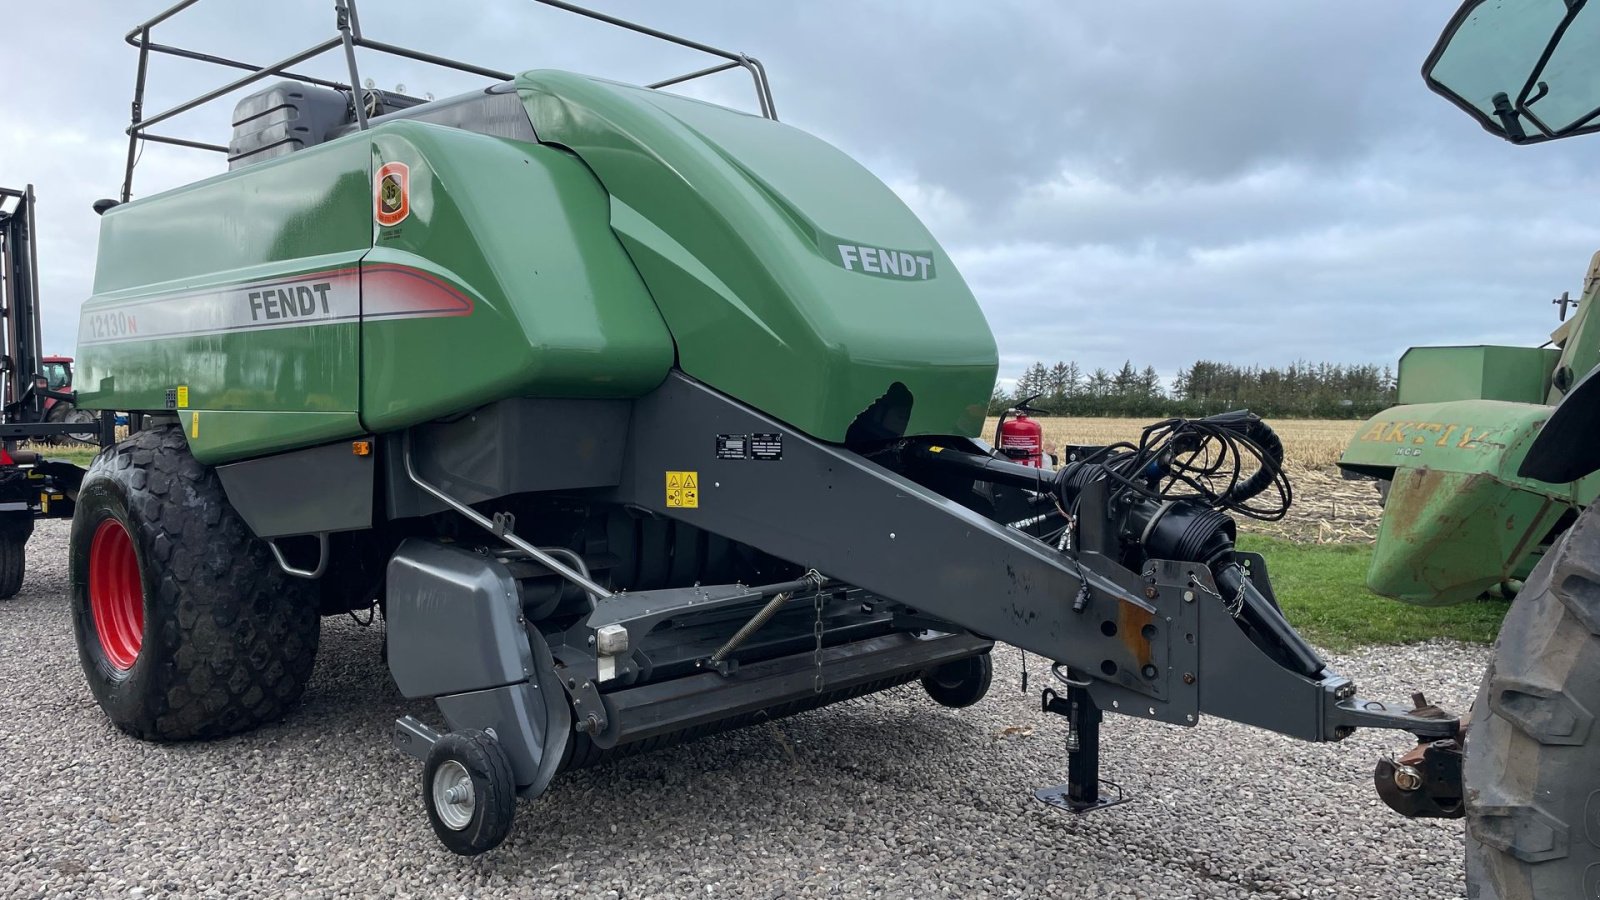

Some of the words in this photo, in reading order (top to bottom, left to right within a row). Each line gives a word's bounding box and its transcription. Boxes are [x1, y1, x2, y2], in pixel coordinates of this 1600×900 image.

[386, 185, 396, 199] 35
[838, 244, 931, 280] FENDT
[248, 282, 331, 321] FENDT
